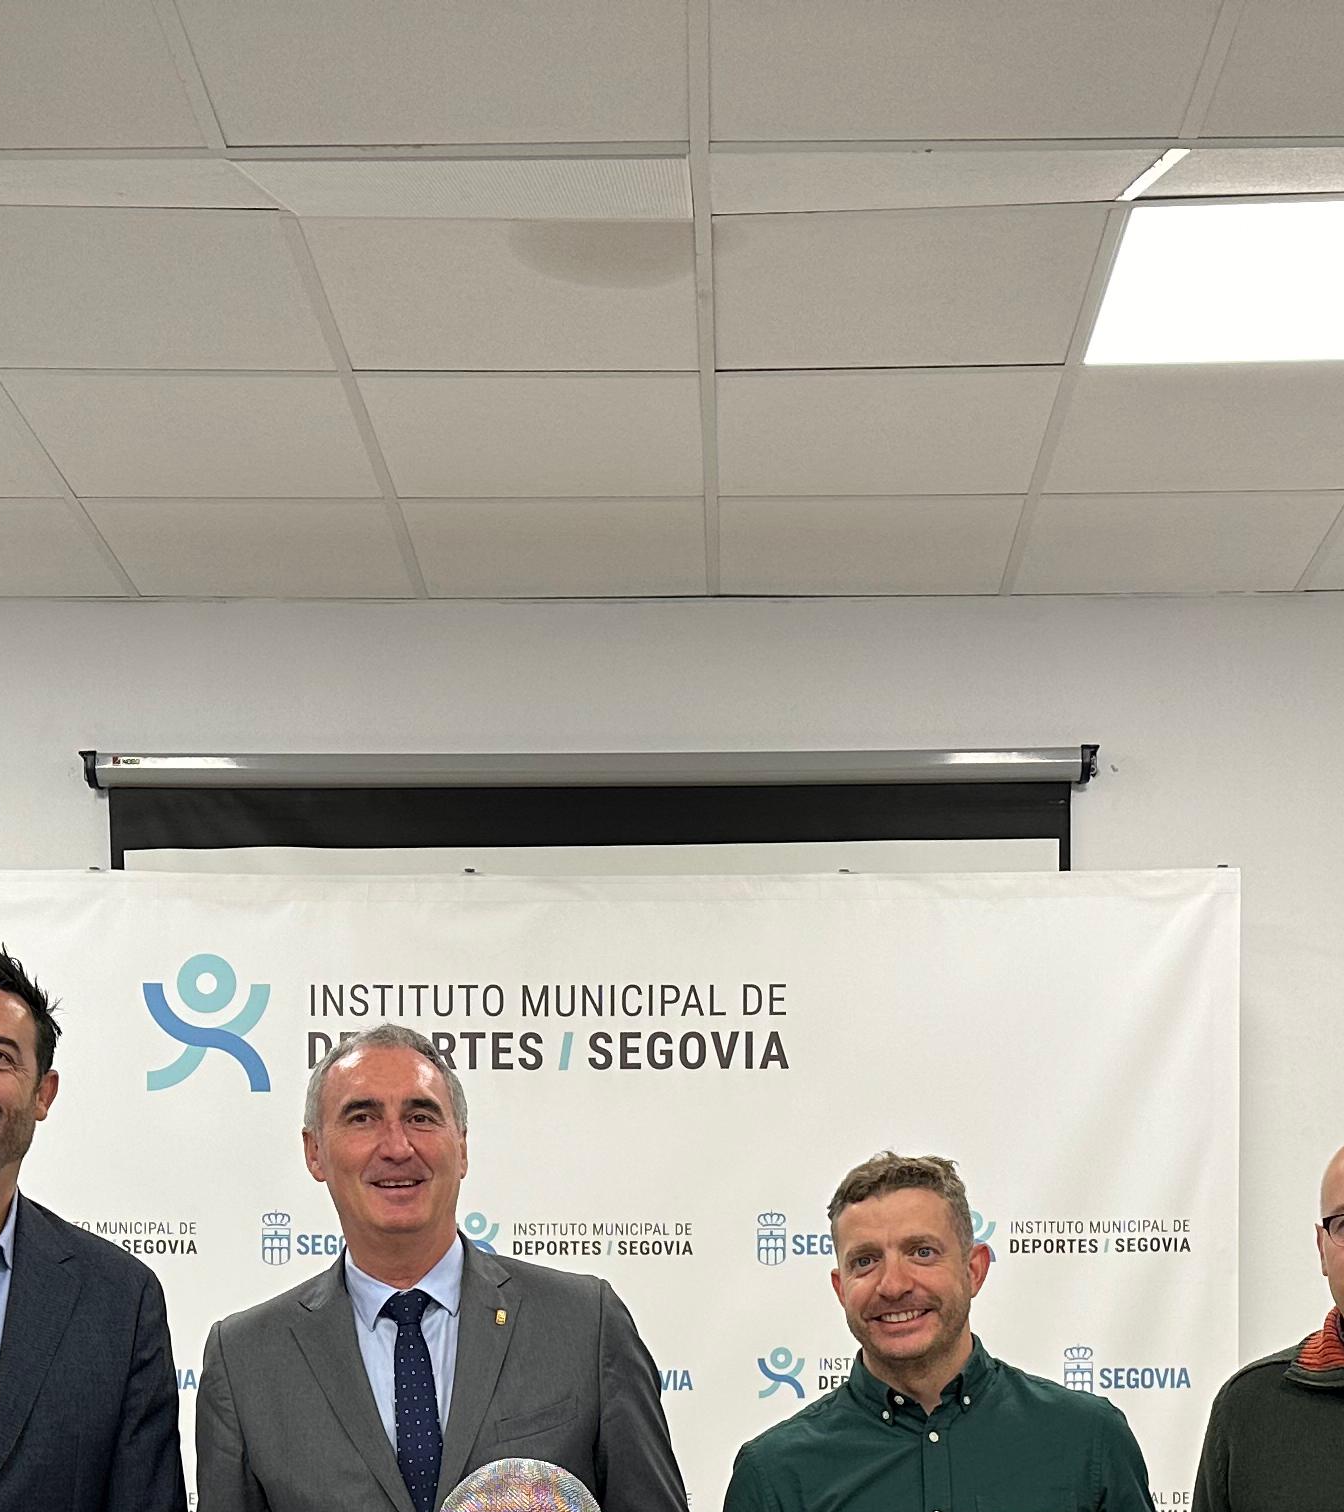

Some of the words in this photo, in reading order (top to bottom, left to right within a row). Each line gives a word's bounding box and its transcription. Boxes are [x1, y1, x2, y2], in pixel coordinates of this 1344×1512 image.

[310, 984, 504, 1017] INSTITUTO
[521, 984, 726, 1017] MUNICIPAL
[742, 984, 786, 1016] DE
[308, 1031, 544, 1071] DRTES
[558, 1031, 574, 1071] /
[588, 1031, 789, 1070] SEGOVIA
[96, 1222, 173, 1235] MUNICIPAL
[179, 1222, 197, 1235] DE
[513, 1223, 587, 1236] INSTITUTO
[592, 1223, 669, 1236] MUNICIPAL
[675, 1223, 692, 1235] DE
[1010, 1221, 1084, 1234] INSTITUTO
[1089, 1220, 1168, 1234] MUNICIPAL
[1173, 1219, 1190, 1232] DE
[122, 1239, 197, 1255] SEGOVIA
[513, 1241, 601, 1256] DEPORTES
[617, 1241, 693, 1256] SEGOVIA
[1009, 1239, 1098, 1254] DEPORTES
[1115, 1237, 1191, 1252] SEGOVIA
[1099, 1367, 1191, 1389] SEGOVIA
[1173, 1492, 1189, 1504] DE
